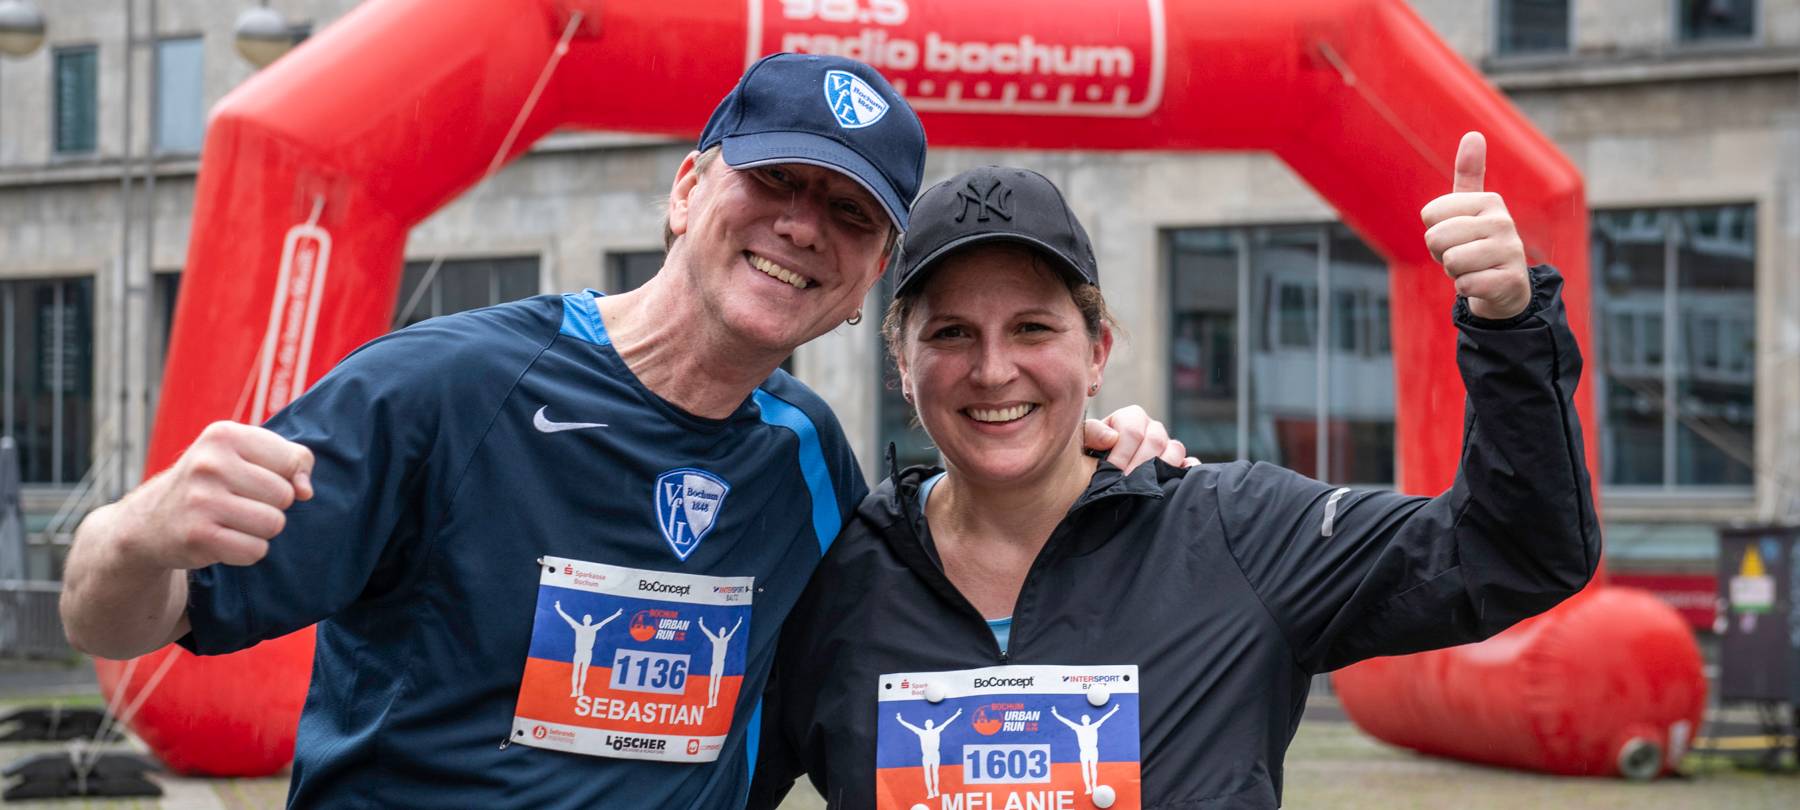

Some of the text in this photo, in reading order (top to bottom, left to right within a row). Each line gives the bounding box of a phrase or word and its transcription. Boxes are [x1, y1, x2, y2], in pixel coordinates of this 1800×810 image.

[925, 33, 1134, 77] bochum
[854, 87, 883, 110] Bochum
[687, 487, 719, 501] Bochum
[692, 501, 709, 513] 1848
[639, 579, 691, 596] BoConcept
[659, 618, 690, 631] URBAN
[655, 630, 675, 640] RUN
[617, 655, 687, 690] 1136
[974, 676, 1034, 688] BoConcept
[574, 695, 705, 725] SEBASTIAN
[1004, 710, 1040, 721] URBAN
[1003, 721, 1025, 731] RUN
[605, 735, 667, 751] LÖSCHER
[966, 750, 1048, 779] 1603
[941, 791, 1075, 810] MELANIE
